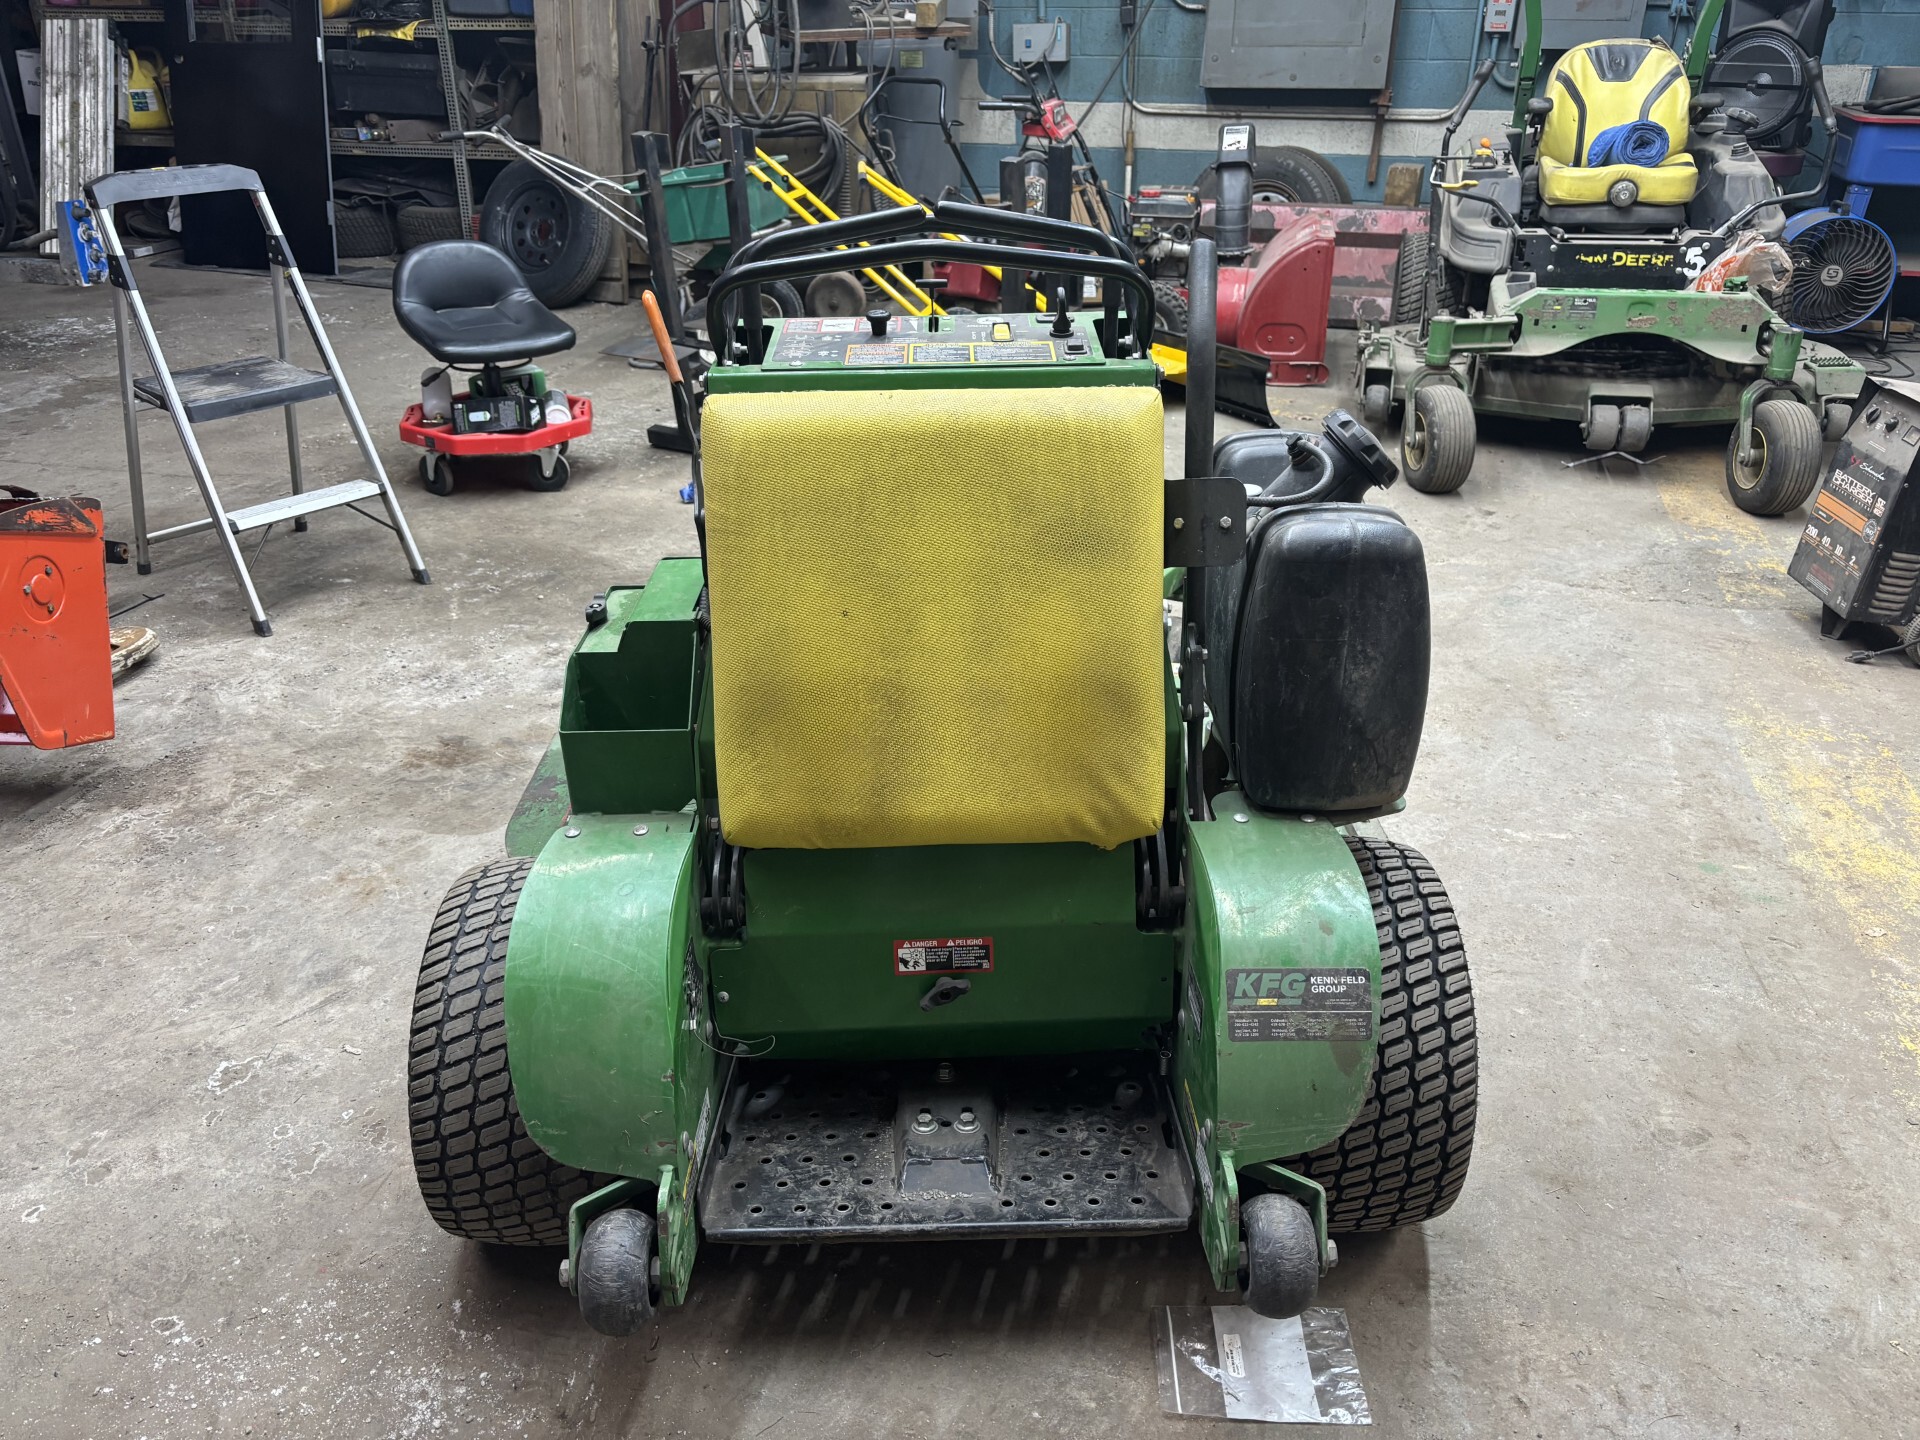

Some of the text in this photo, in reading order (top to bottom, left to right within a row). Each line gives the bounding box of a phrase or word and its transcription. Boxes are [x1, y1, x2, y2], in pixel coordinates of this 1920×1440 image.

[1682, 246, 1707, 277] 5
[1835, 468, 1876, 498] BATTERY
[1832, 475, 1873, 507] CHARGER
[1805, 524, 1819, 538] 200
[1821, 535, 1831, 547] 40
[1834, 544, 1844, 556] 10
[1849, 555, 1856, 566] 2
[911, 940, 938, 948] DANGER
[955, 938, 983, 946] PELIGRO
[1234, 972, 1307, 997] KFG
[1311, 984, 1347, 993] GROUP
